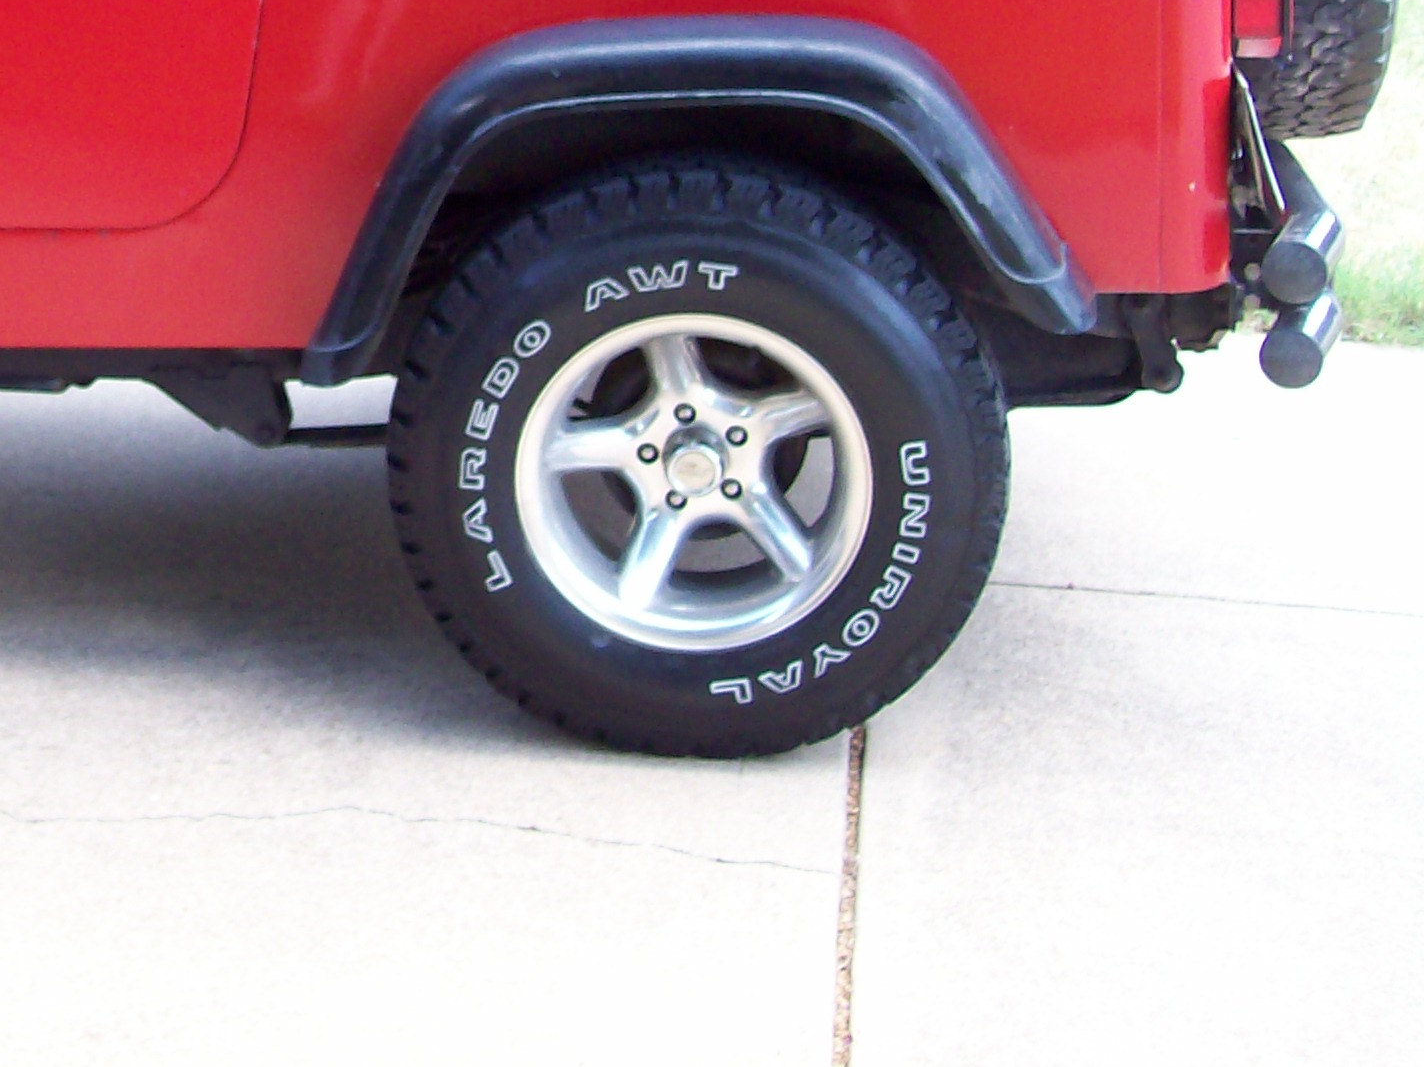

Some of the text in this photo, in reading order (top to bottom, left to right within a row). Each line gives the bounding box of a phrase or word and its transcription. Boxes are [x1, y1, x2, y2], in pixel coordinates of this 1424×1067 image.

[459, 261, 739, 592] LAREDO AWT
[709, 441, 931, 704] UNIROYAL
